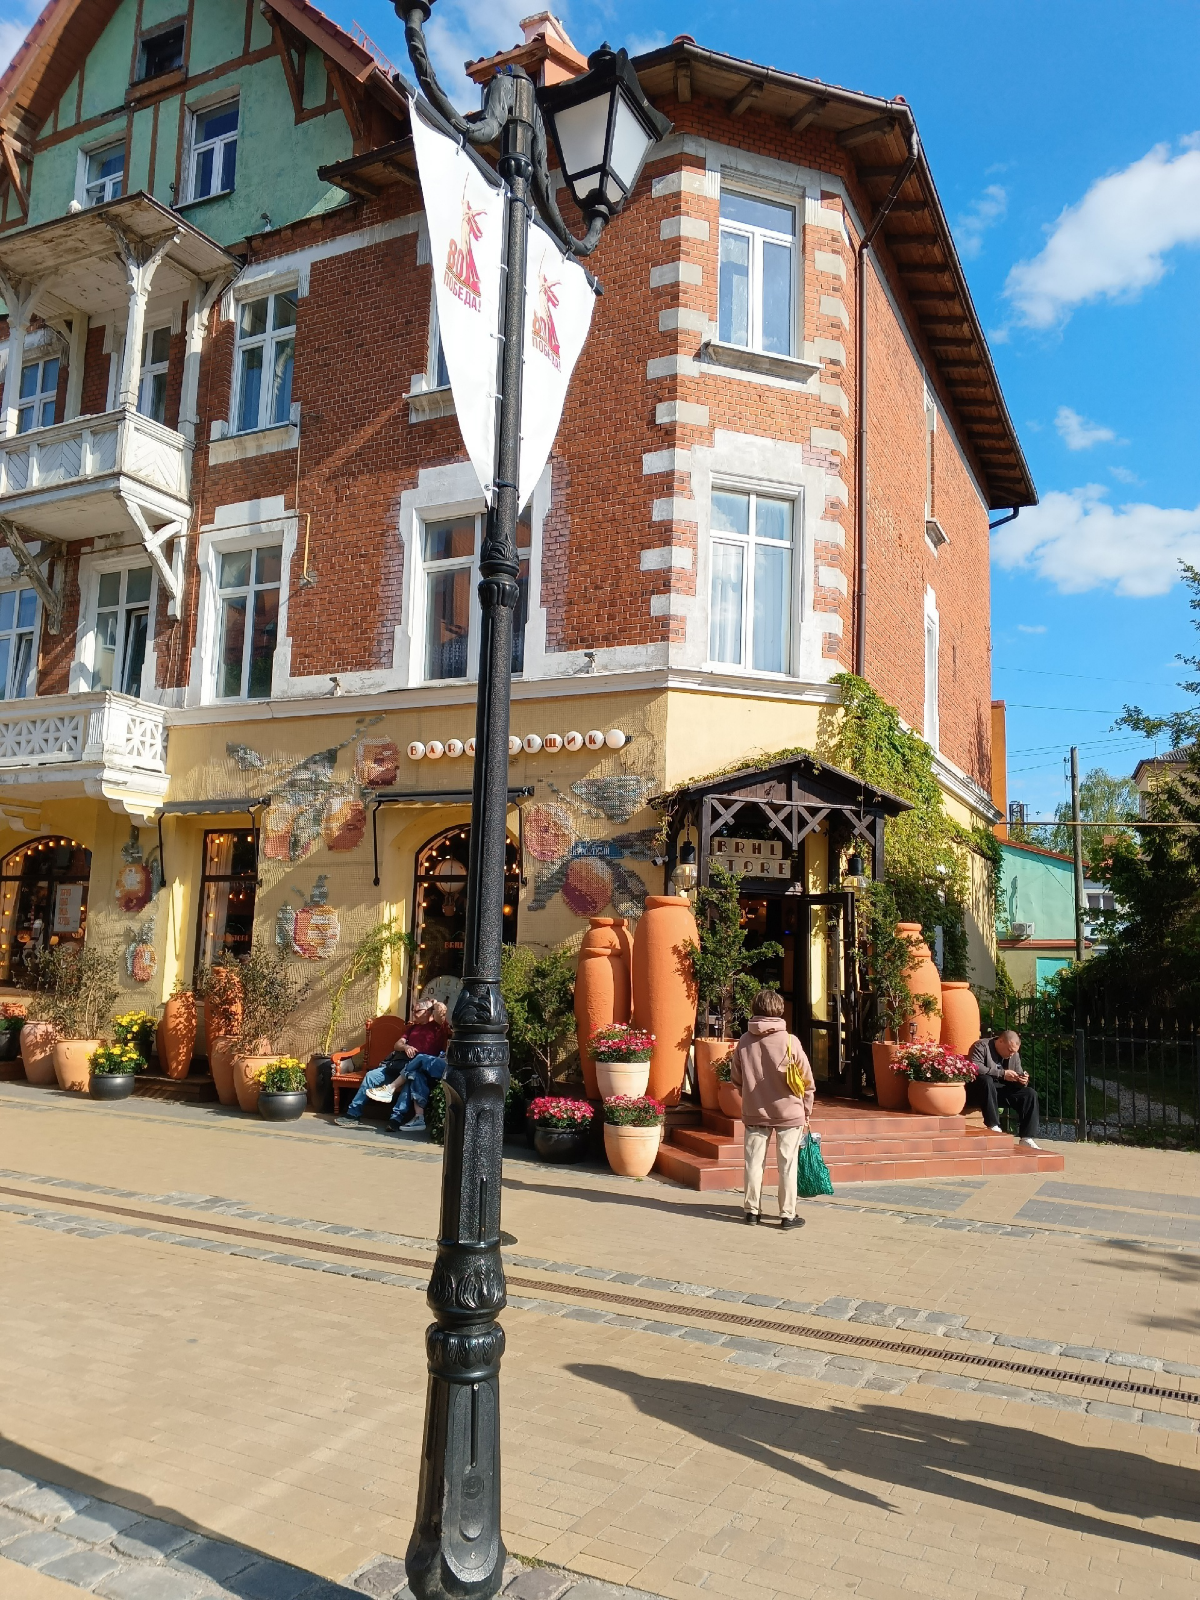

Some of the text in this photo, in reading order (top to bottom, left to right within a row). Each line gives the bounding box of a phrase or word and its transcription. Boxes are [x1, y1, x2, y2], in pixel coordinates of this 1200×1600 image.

[447, 238, 465, 280] 80
[443, 270, 482, 313] ПОБЕДА!
[717, 840, 778, 856] BRHL
